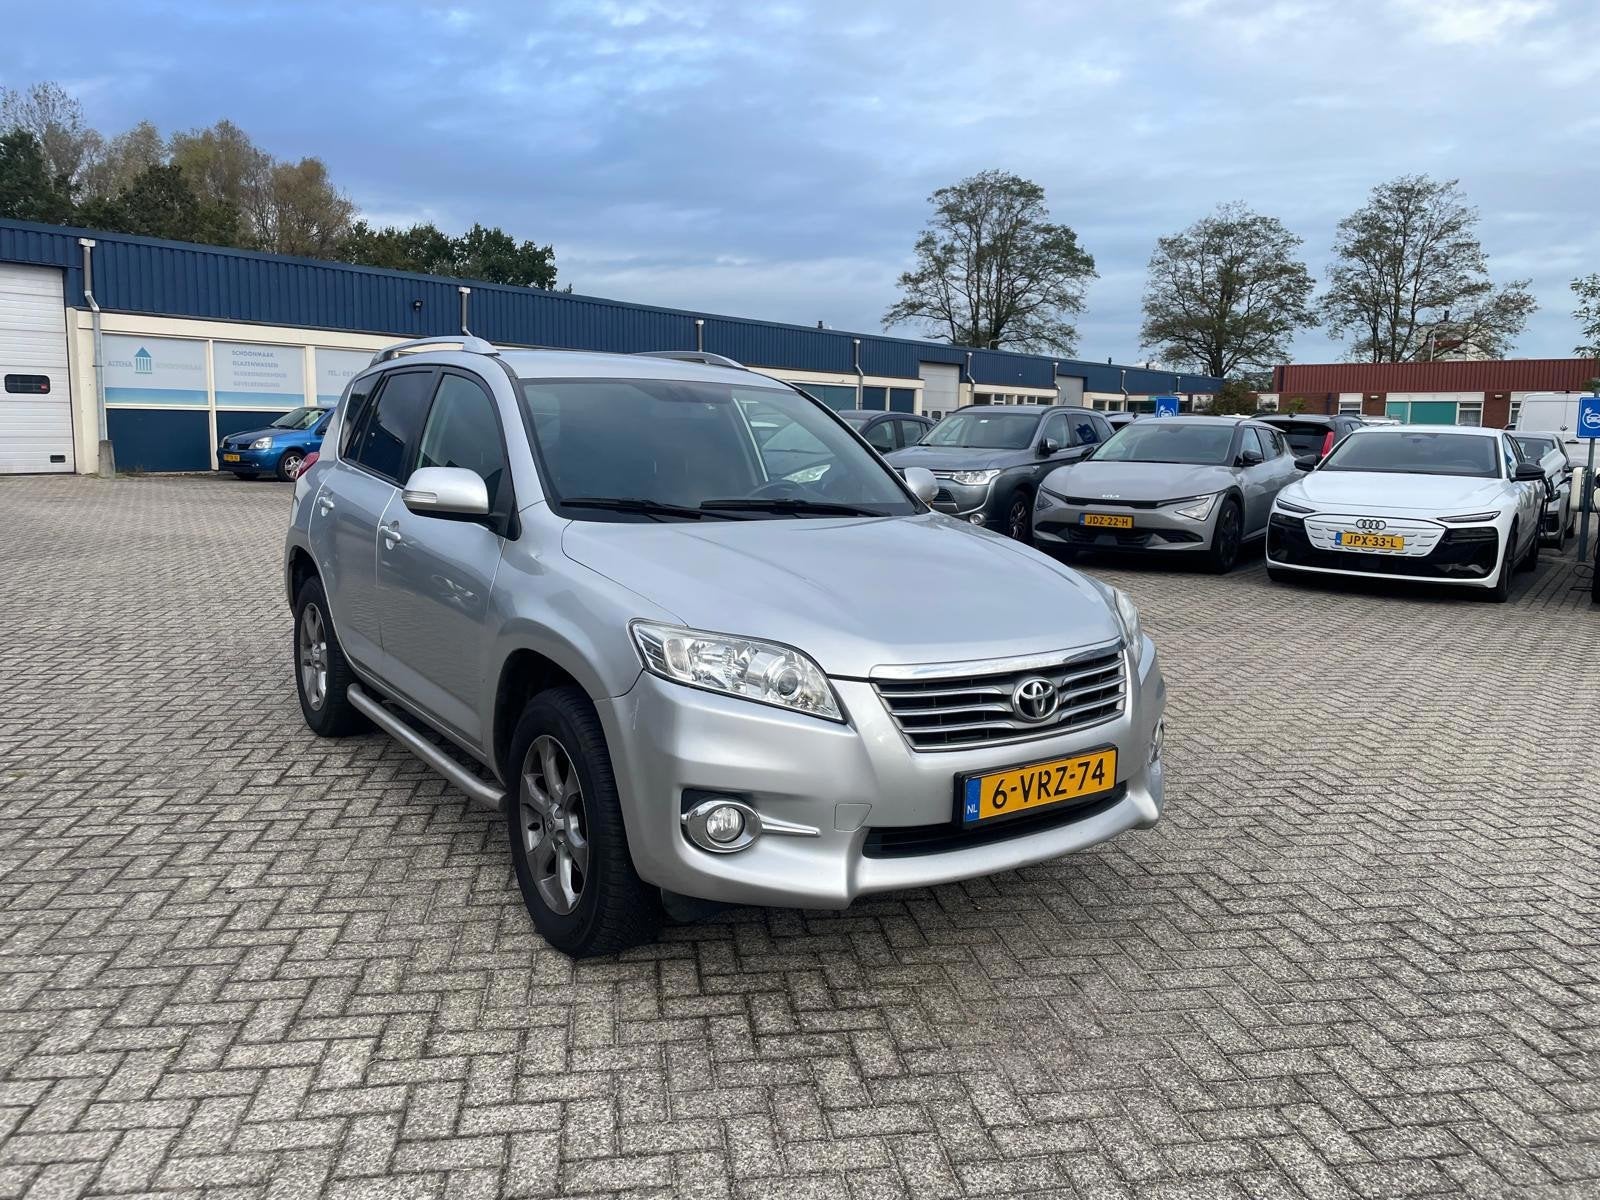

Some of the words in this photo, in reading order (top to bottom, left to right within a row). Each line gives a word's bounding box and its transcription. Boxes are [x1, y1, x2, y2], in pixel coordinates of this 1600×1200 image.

[1087, 515, 1128, 527] JDZ-22-H
[1346, 535, 1397, 548] JPX-33-L
[991, 757, 1105, 809] 6-VRZ-74
[966, 804, 978, 815] NL
